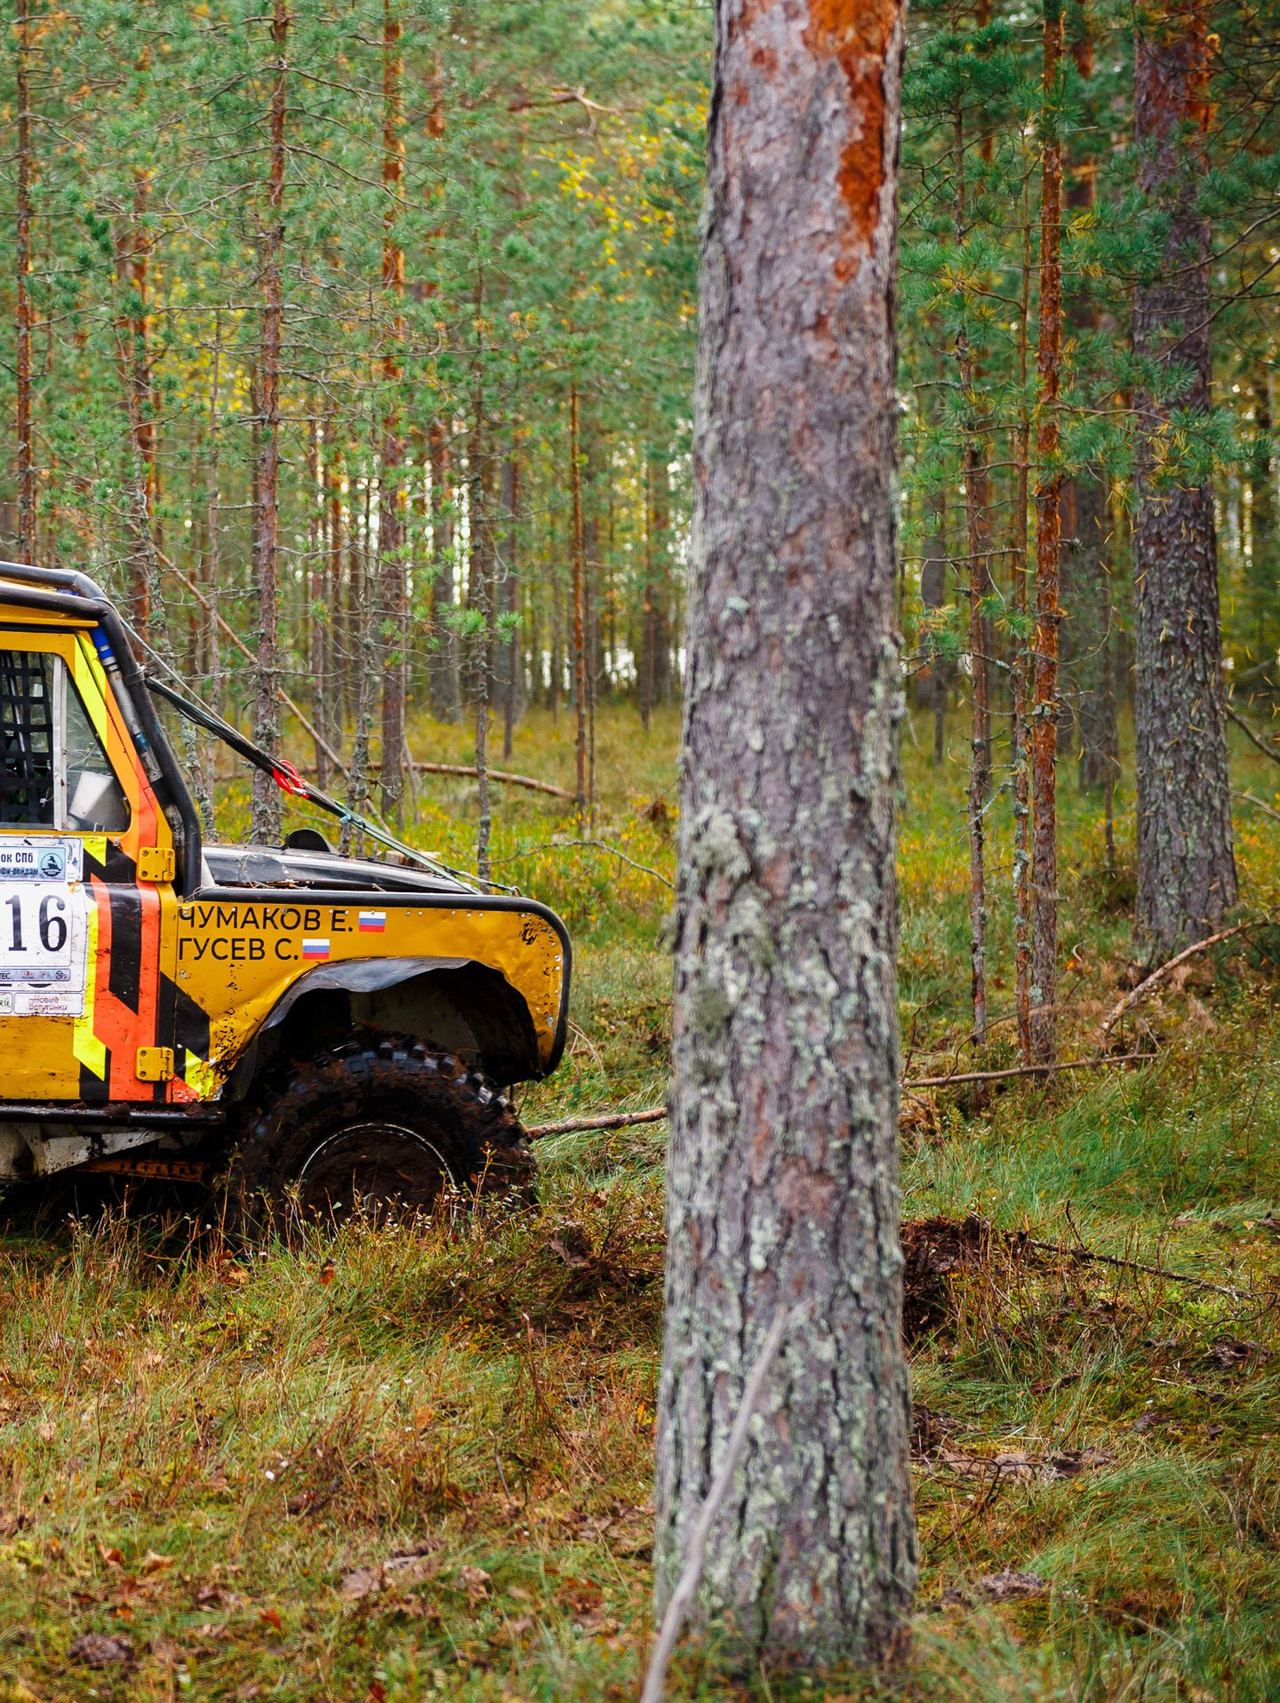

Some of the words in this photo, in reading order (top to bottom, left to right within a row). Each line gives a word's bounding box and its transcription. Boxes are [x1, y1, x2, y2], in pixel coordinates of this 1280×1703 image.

[15, 852, 34, 863] СПб
[179, 906, 320, 931] ЧУМАКОВ
[331, 909, 353, 932] Е.
[178, 938, 265, 961] ГУСЕВ
[275, 937, 299, 961] С.
